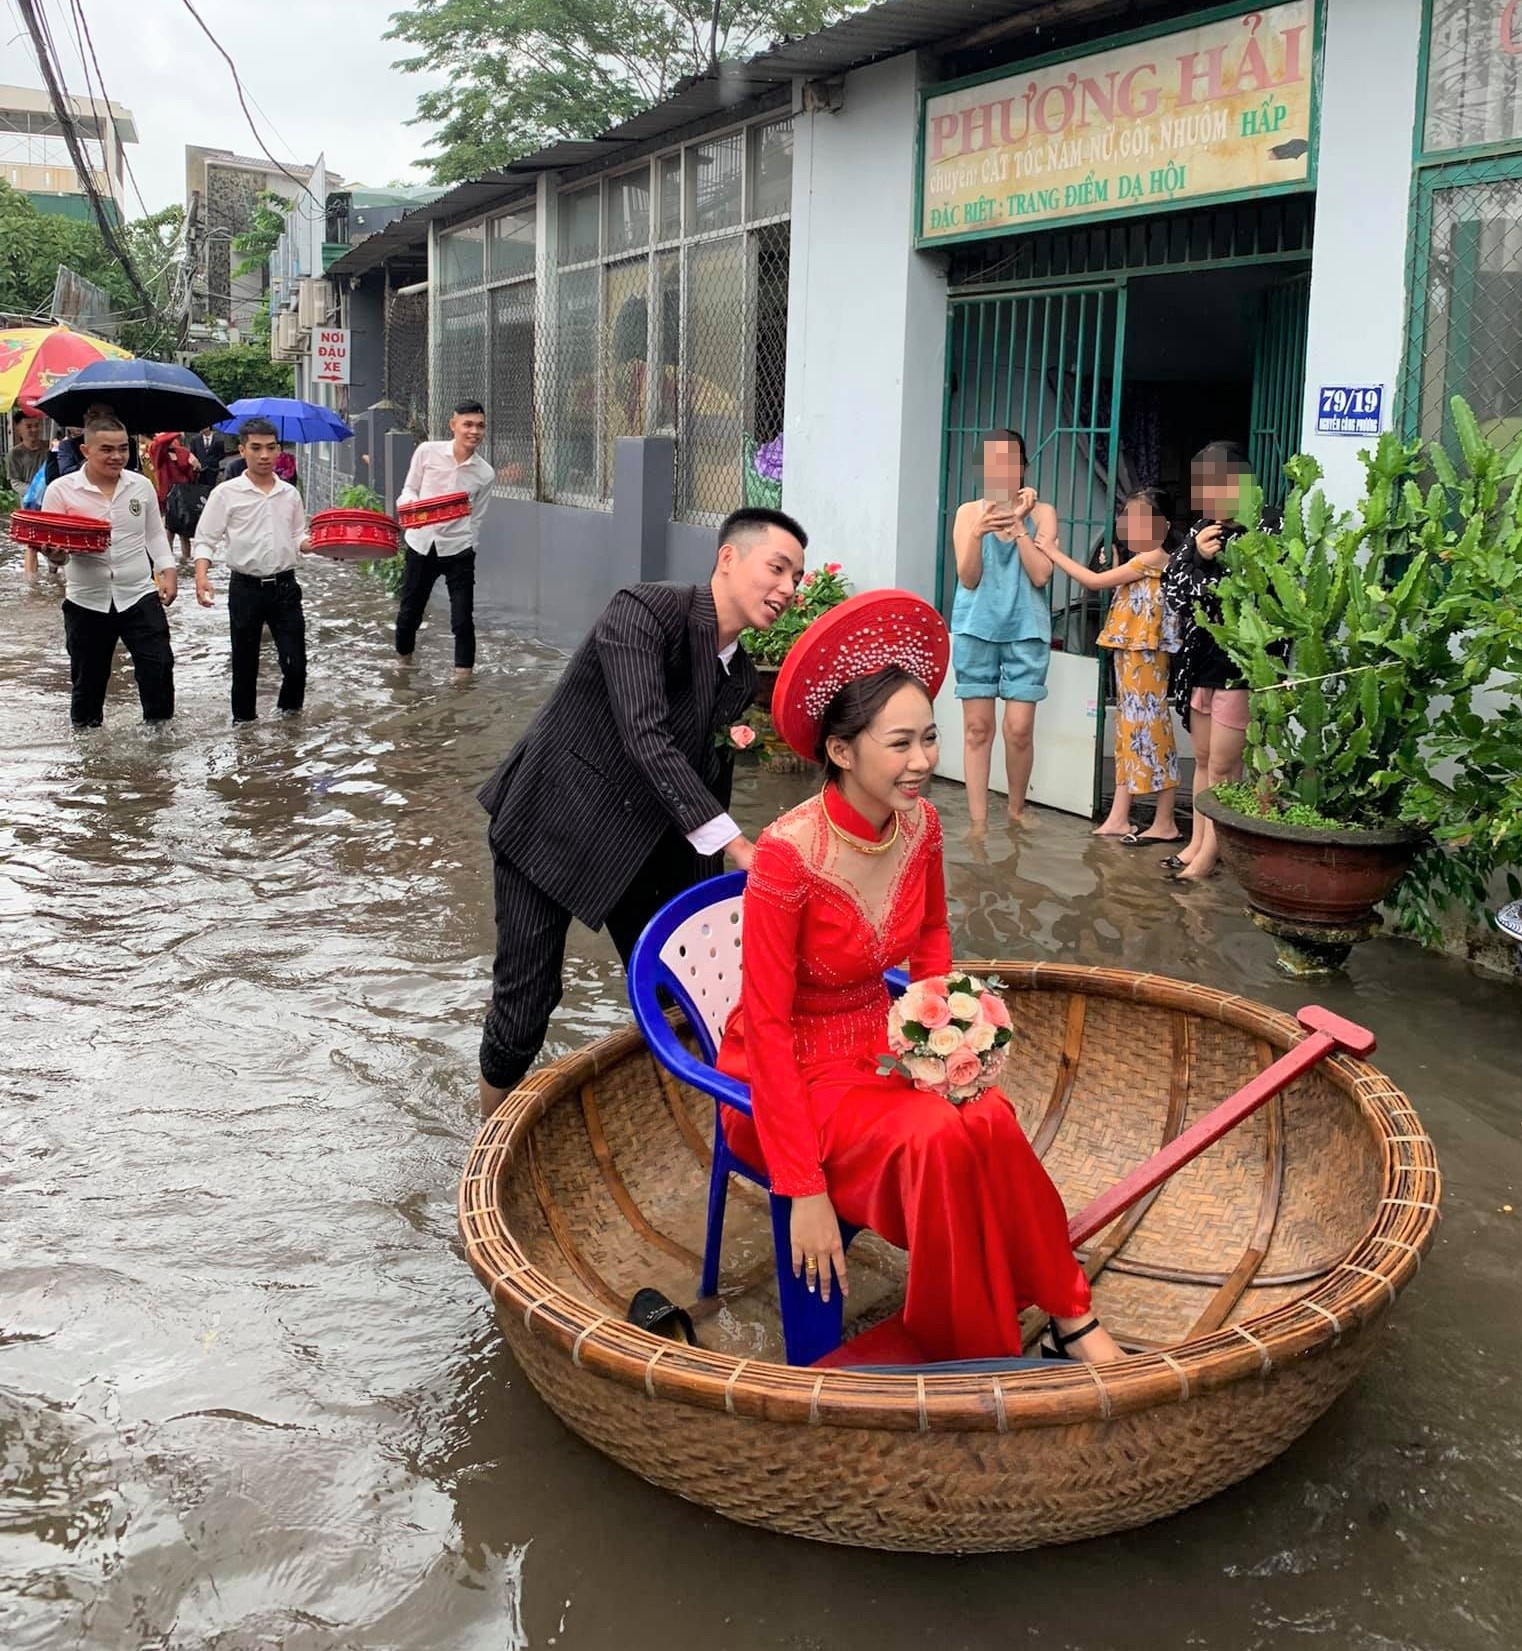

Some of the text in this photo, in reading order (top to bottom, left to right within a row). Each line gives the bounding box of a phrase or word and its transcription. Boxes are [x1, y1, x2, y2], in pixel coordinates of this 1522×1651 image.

[930, 13, 1307, 161] PHƯƠNG HẢI
[1159, 104, 1229, 151] NHUỘM
[1240, 94, 1287, 137] HẤP
[930, 201, 960, 232] ĐẶC
[1007, 187, 1060, 217] TRANG
[1064, 169, 1109, 208] ĐIỂM
[1117, 173, 1144, 202] DẠ
[1149, 159, 1187, 201] HỘI
[320, 331, 345, 343] NƠI
[318, 344, 346, 361] ĐẬU
[323, 361, 342, 372] XE
[1322, 390, 1378, 415] 79/19
